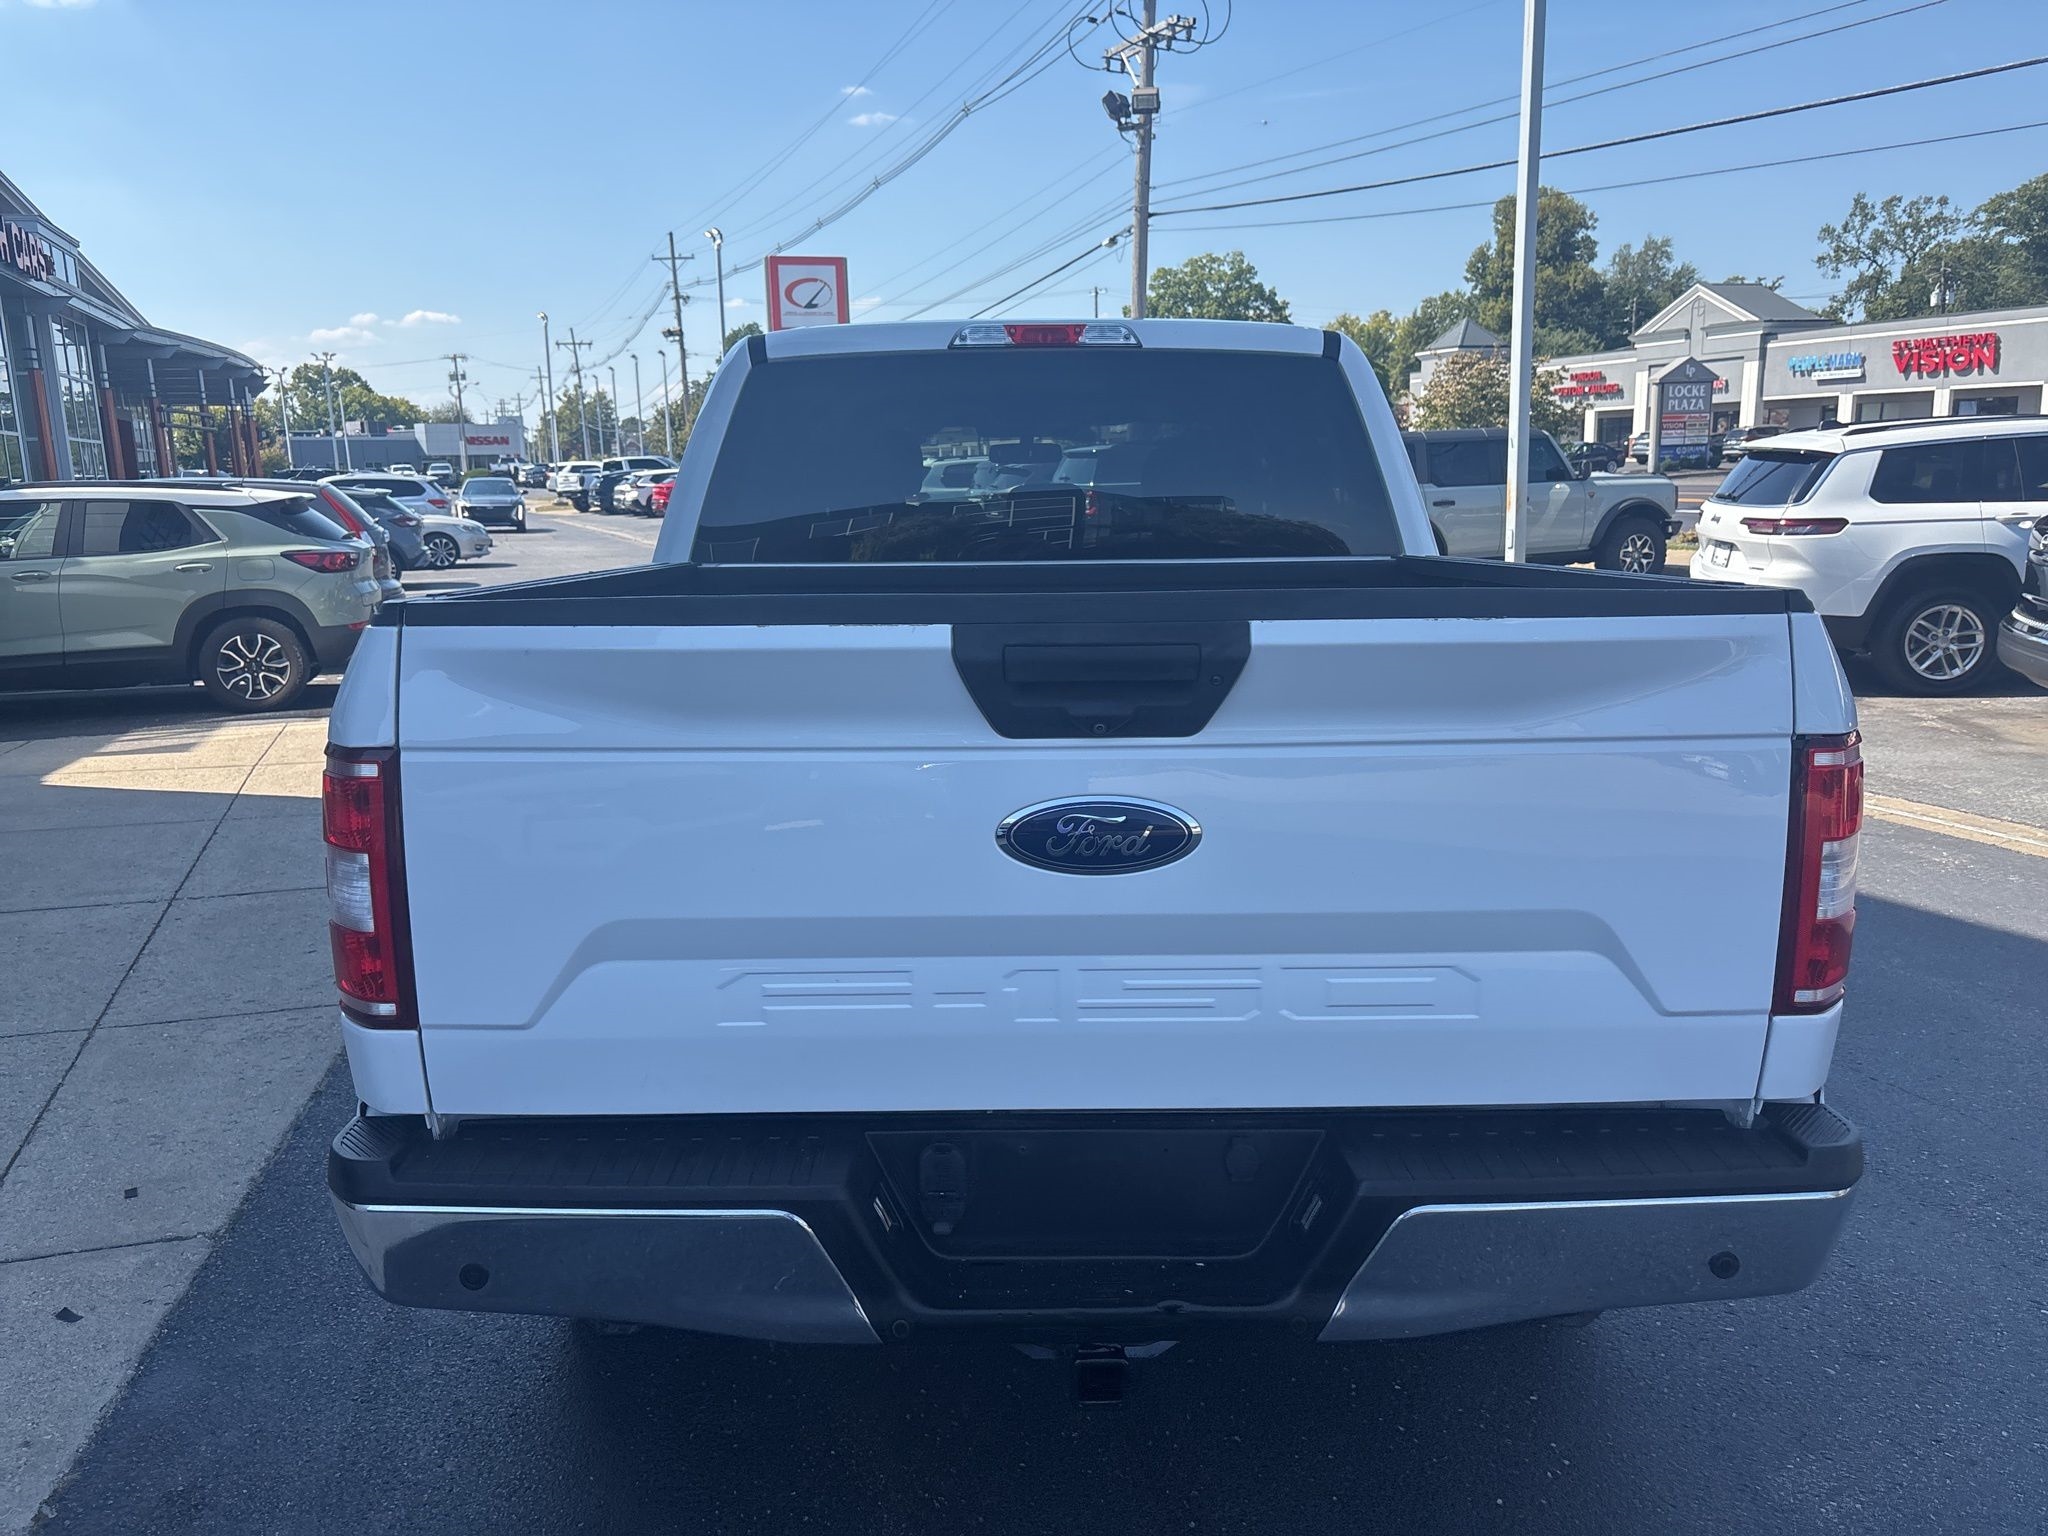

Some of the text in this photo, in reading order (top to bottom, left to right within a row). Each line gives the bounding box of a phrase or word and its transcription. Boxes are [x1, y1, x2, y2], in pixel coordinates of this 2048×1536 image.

[11, 221, 47, 282] CARS
[1914, 332, 1996, 350] MATTHEWS
[1892, 346, 1996, 374] VISION
[1667, 398, 1705, 411] PLAZA
[1668, 385, 1706, 398] LOCKE
[1045, 812, 1153, 857] Ford
[716, 965, 1482, 1027] F-150
